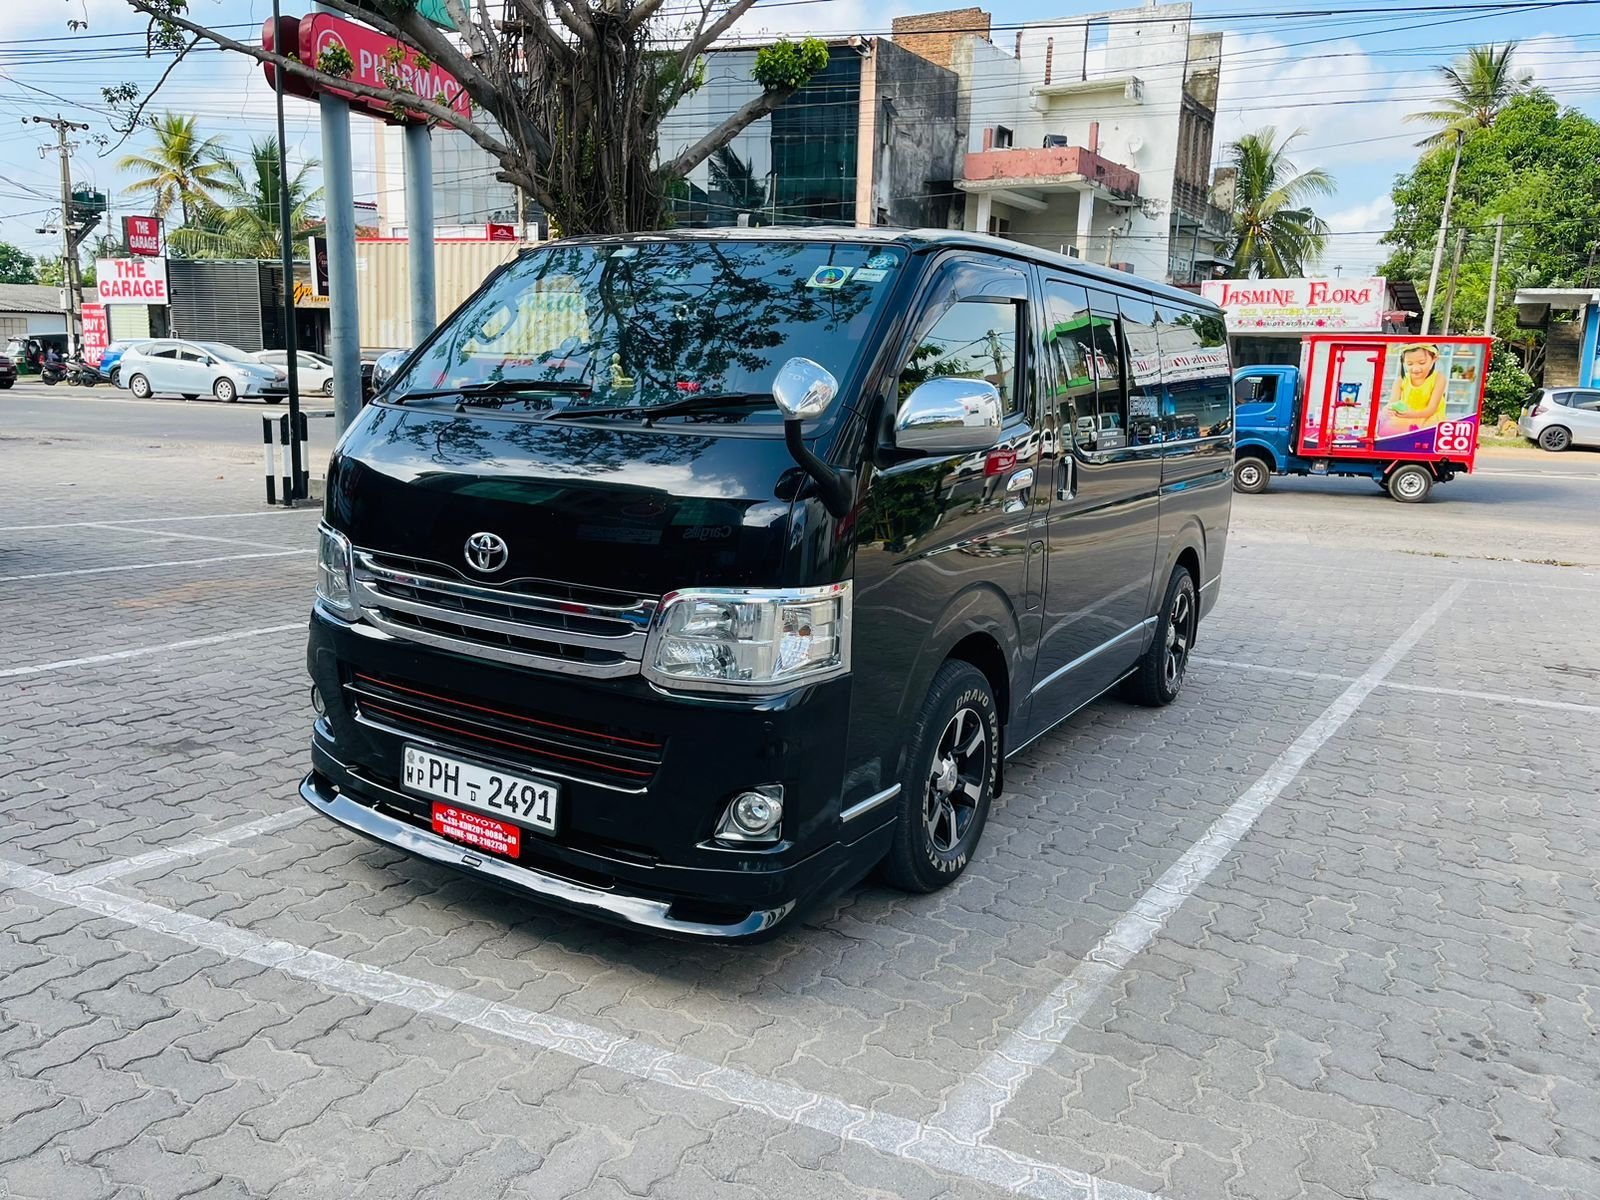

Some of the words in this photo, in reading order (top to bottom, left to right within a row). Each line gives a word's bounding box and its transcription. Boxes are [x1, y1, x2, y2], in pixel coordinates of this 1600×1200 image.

[360, 49, 464, 109] PHARMACY
[135, 221, 149, 234] THE
[130, 235, 157, 249] GARAGE
[115, 261, 146, 278] THE
[100, 280, 164, 297] GARAGE
[83, 318, 99, 331] BUY
[85, 332, 100, 345] GET
[955, 688, 989, 711] BRAVO
[459, 812, 503, 831] TOYOTA
